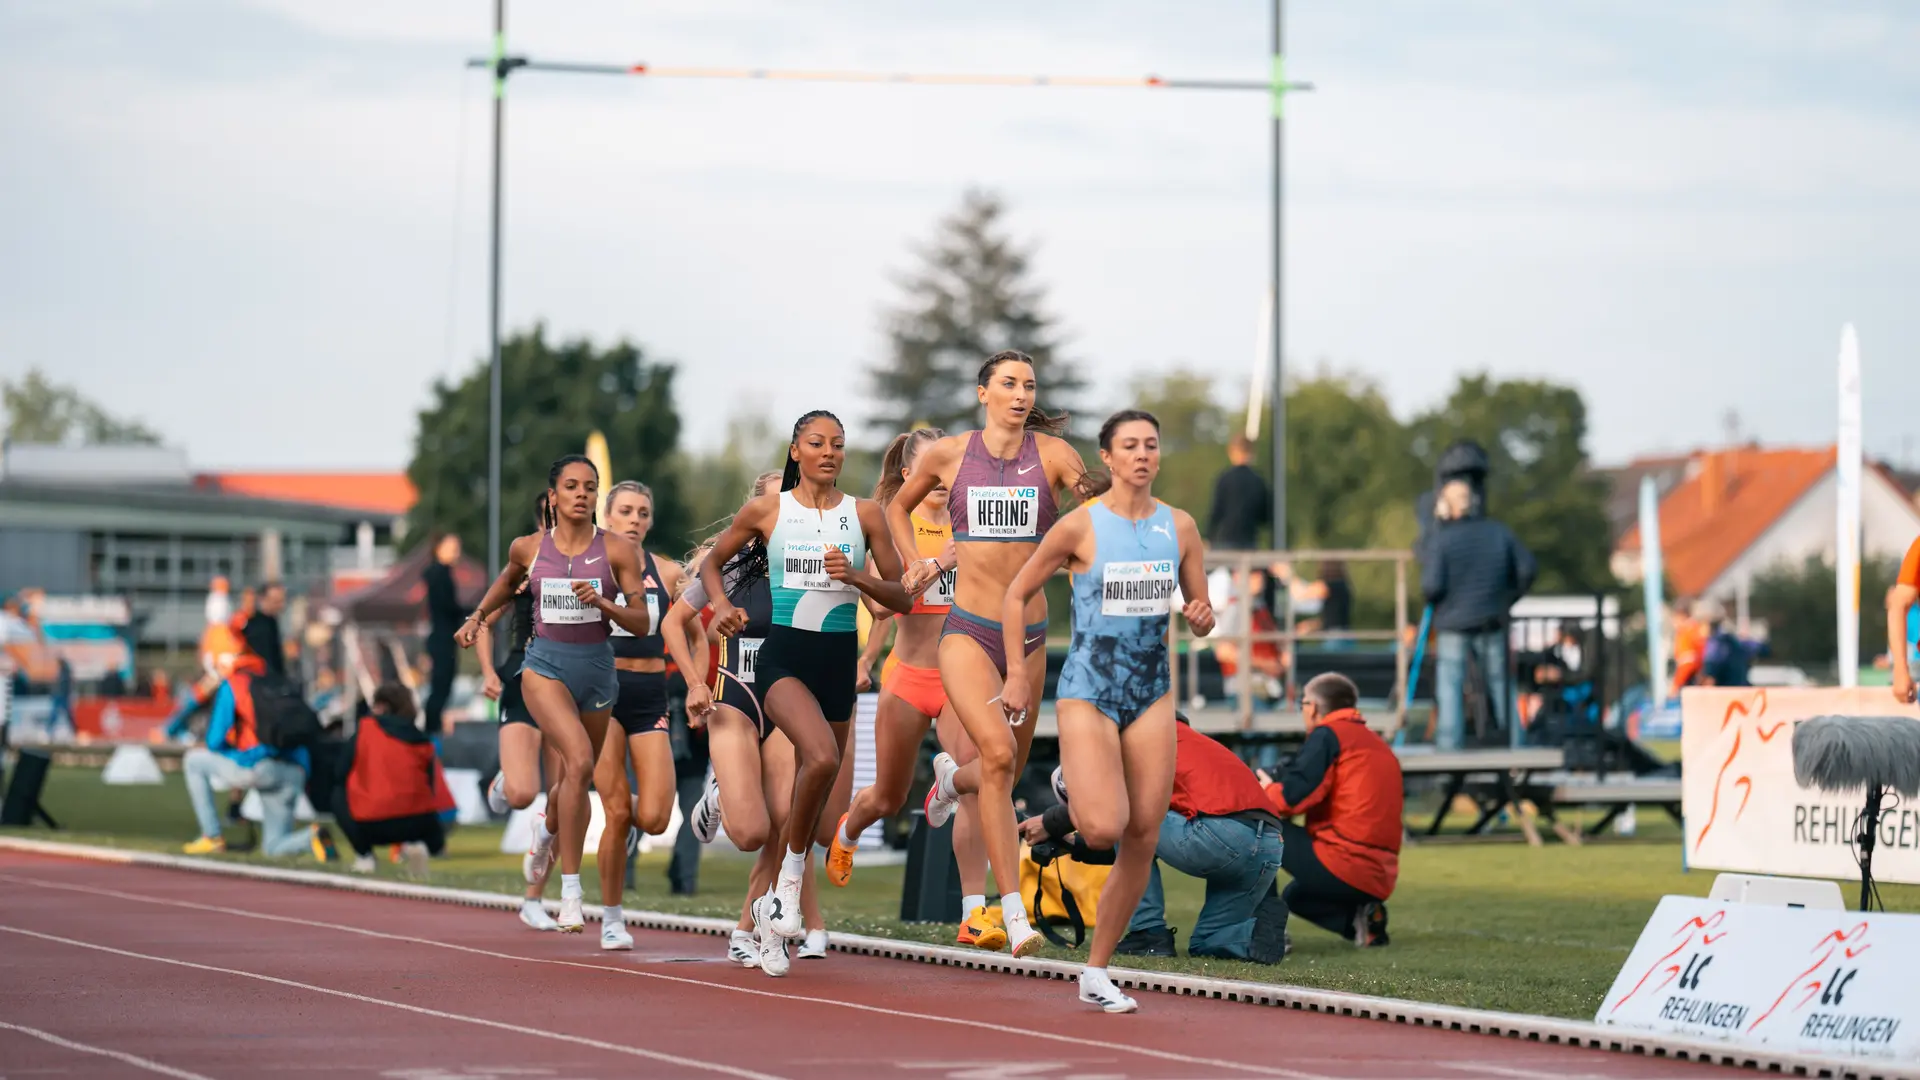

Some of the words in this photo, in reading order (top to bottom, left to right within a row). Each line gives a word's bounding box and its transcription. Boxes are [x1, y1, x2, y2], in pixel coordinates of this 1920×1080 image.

[971, 489, 1005, 497] meine
[1008, 488, 1035, 497] VVB
[978, 500, 1028, 526] HERING
[788, 543, 822, 552] meine
[785, 558, 852, 574] WALCOTT-
[1143, 562, 1170, 572] VVB
[1106, 579, 1173, 600] KOLAKOWSKA
[1794, 804, 1920, 849] REHLIGE
[1659, 996, 1749, 1030] REHLINGEN
[1800, 1012, 1901, 1043] REHLINGEN
